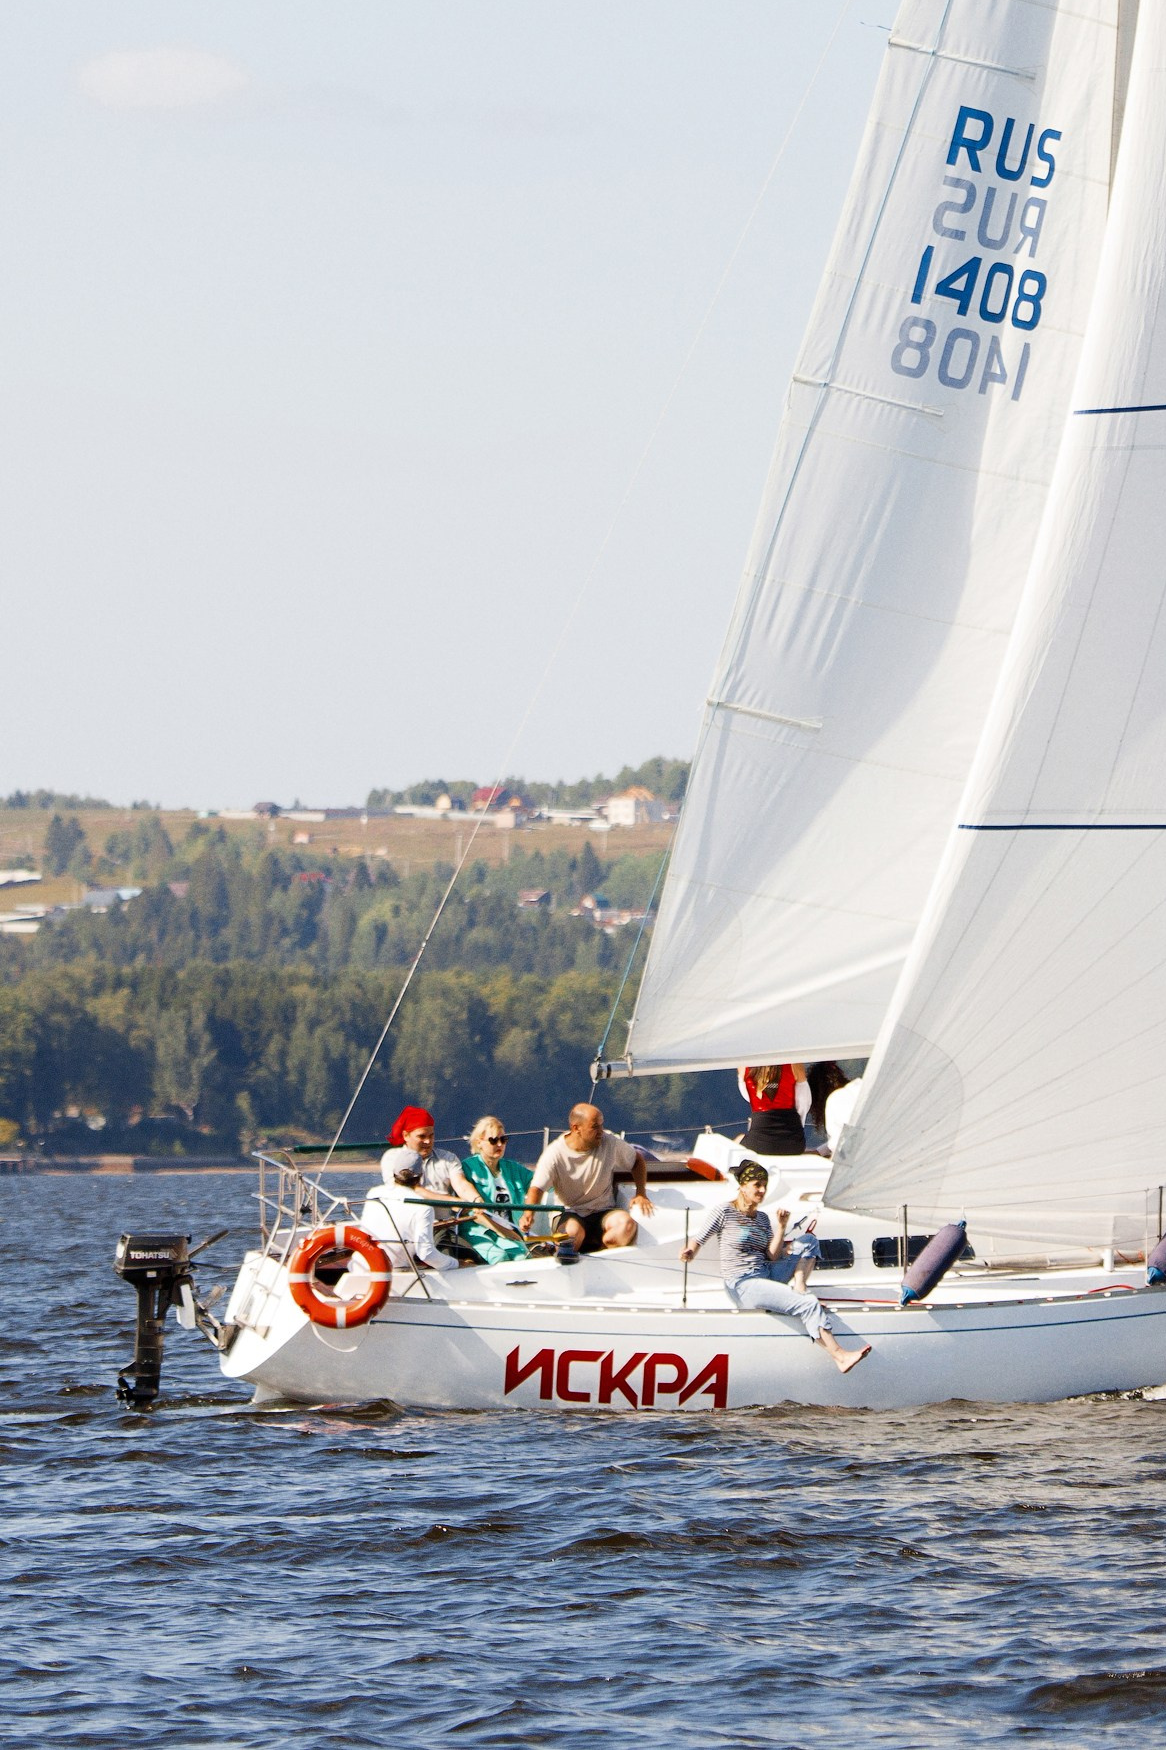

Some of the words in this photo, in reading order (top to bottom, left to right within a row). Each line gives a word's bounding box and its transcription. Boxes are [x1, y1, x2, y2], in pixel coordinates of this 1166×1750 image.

[946, 105, 1062, 189] RUS
[911, 245, 1047, 331] 1408
[129, 1250, 170, 1259] TOHATSU
[504, 1344, 729, 1410] ИСКРА
